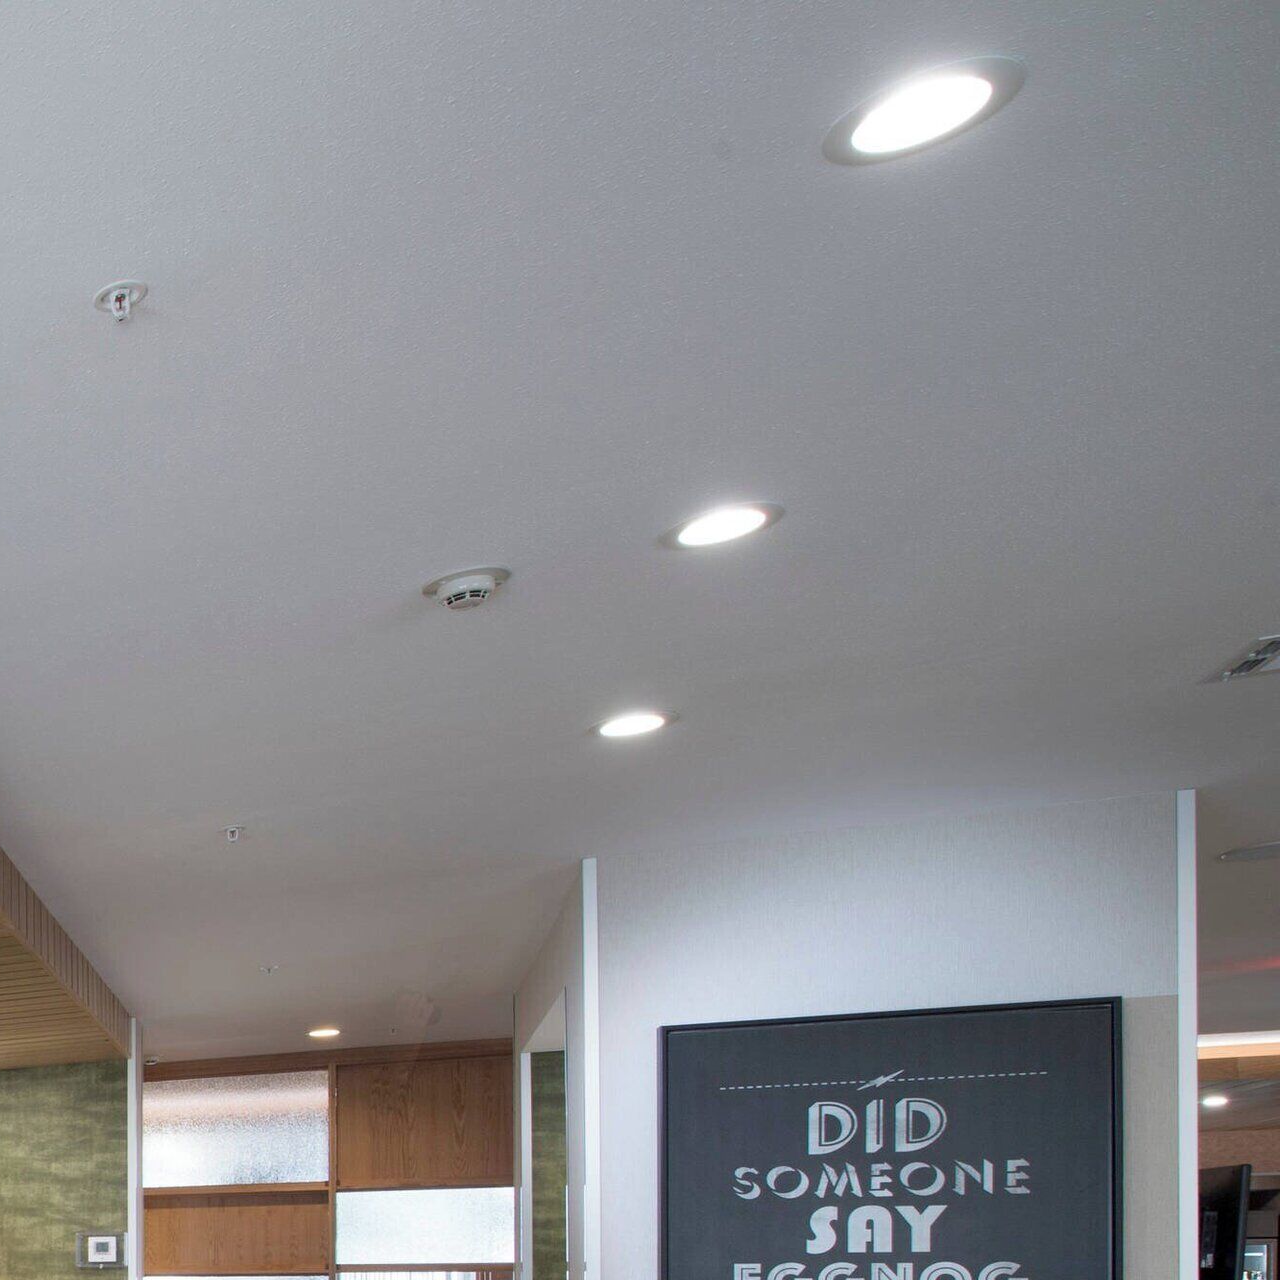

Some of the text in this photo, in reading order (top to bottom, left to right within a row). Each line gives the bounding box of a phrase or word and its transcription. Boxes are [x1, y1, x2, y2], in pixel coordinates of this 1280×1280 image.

[807, 1097, 948, 1156] DID
[732, 1157, 1032, 1200] SOMEONE
[805, 1203, 948, 1255] SAY
